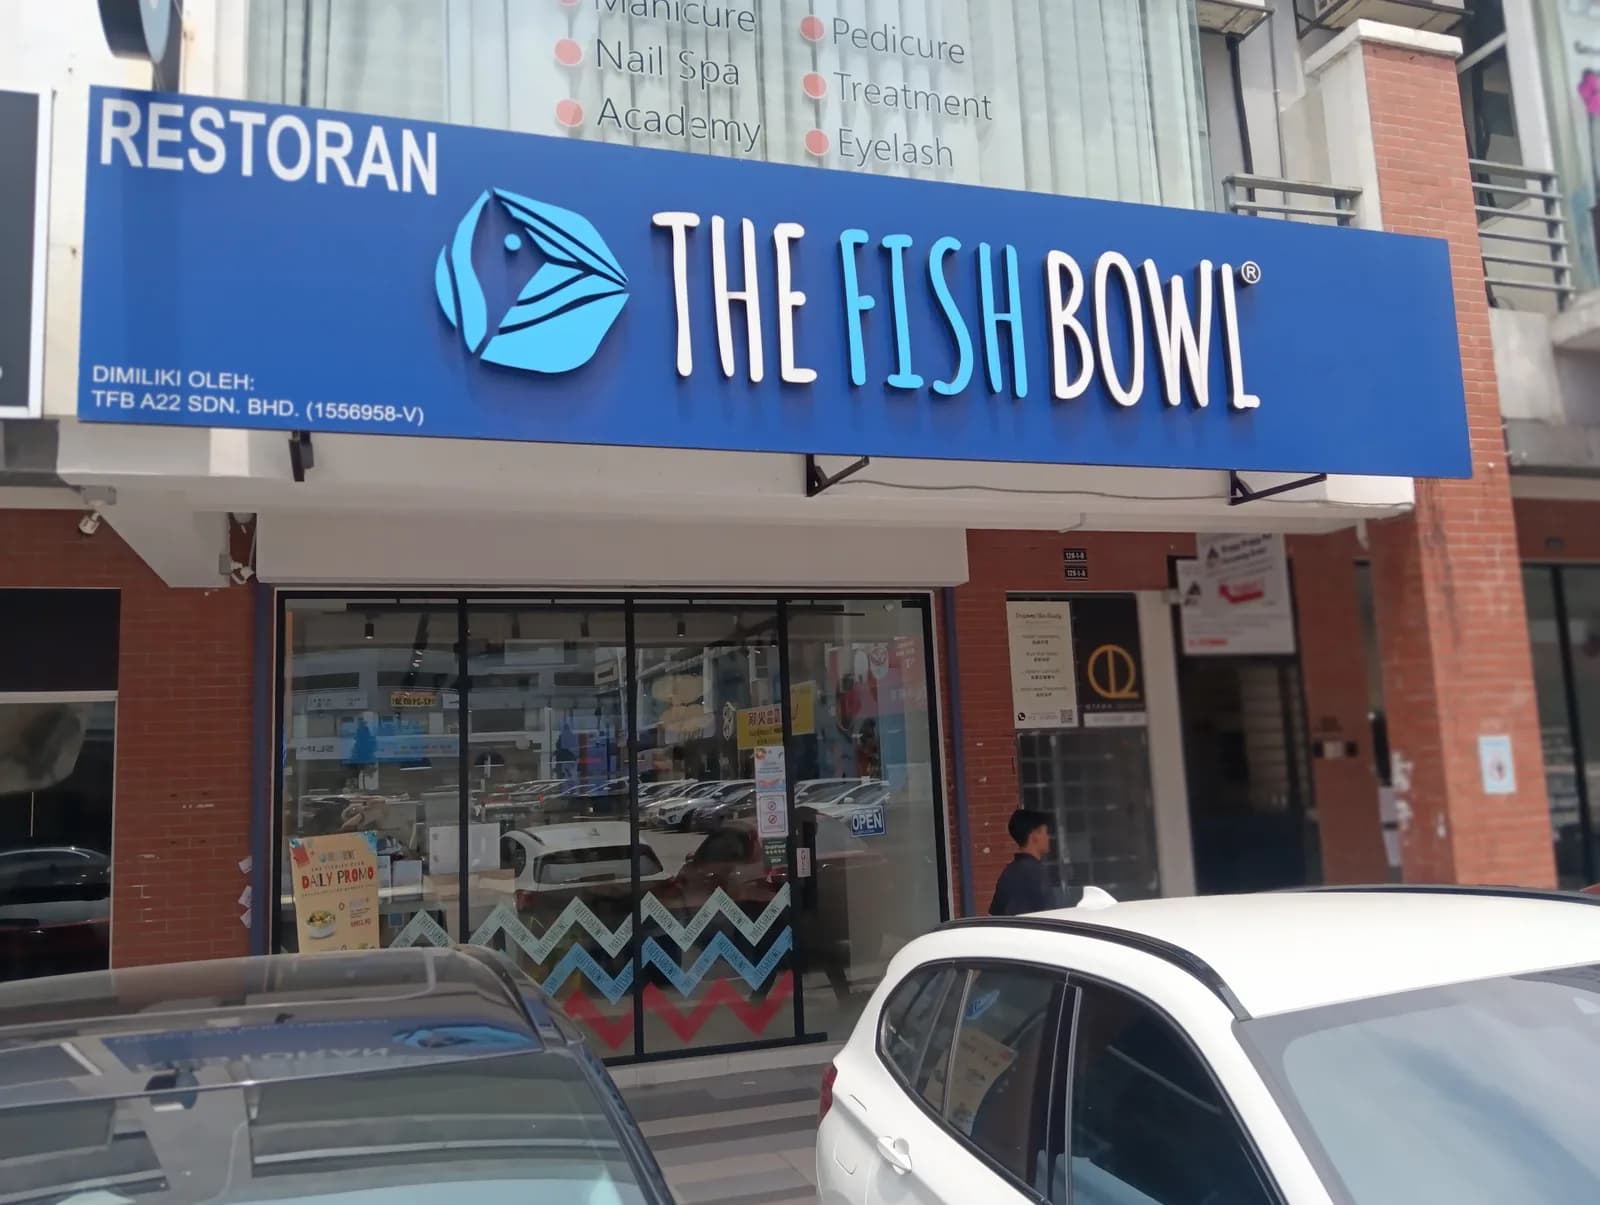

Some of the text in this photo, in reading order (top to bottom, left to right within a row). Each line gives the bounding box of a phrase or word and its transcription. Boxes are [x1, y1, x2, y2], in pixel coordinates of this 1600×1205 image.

[597, 38, 739, 90] Nail Spa
[833, 17, 965, 64] Pedicure
[833, 72, 993, 120] Treatment
[100, 97, 437, 196] RESTORAN
[597, 97, 761, 152] Academy
[839, 127, 954, 167] Eyelash
[652, 211, 818, 384] THE
[840, 229, 1028, 398] FISH
[92, 364, 255, 391] DIMILIKI OLEH:
[92, 389, 425, 427] TFB A22 SDN. BHD. (1556958-V)
[852, 813, 883, 831] OPEN
[302, 871, 332, 889] DAILY
[337, 866, 374, 885] PROMO
